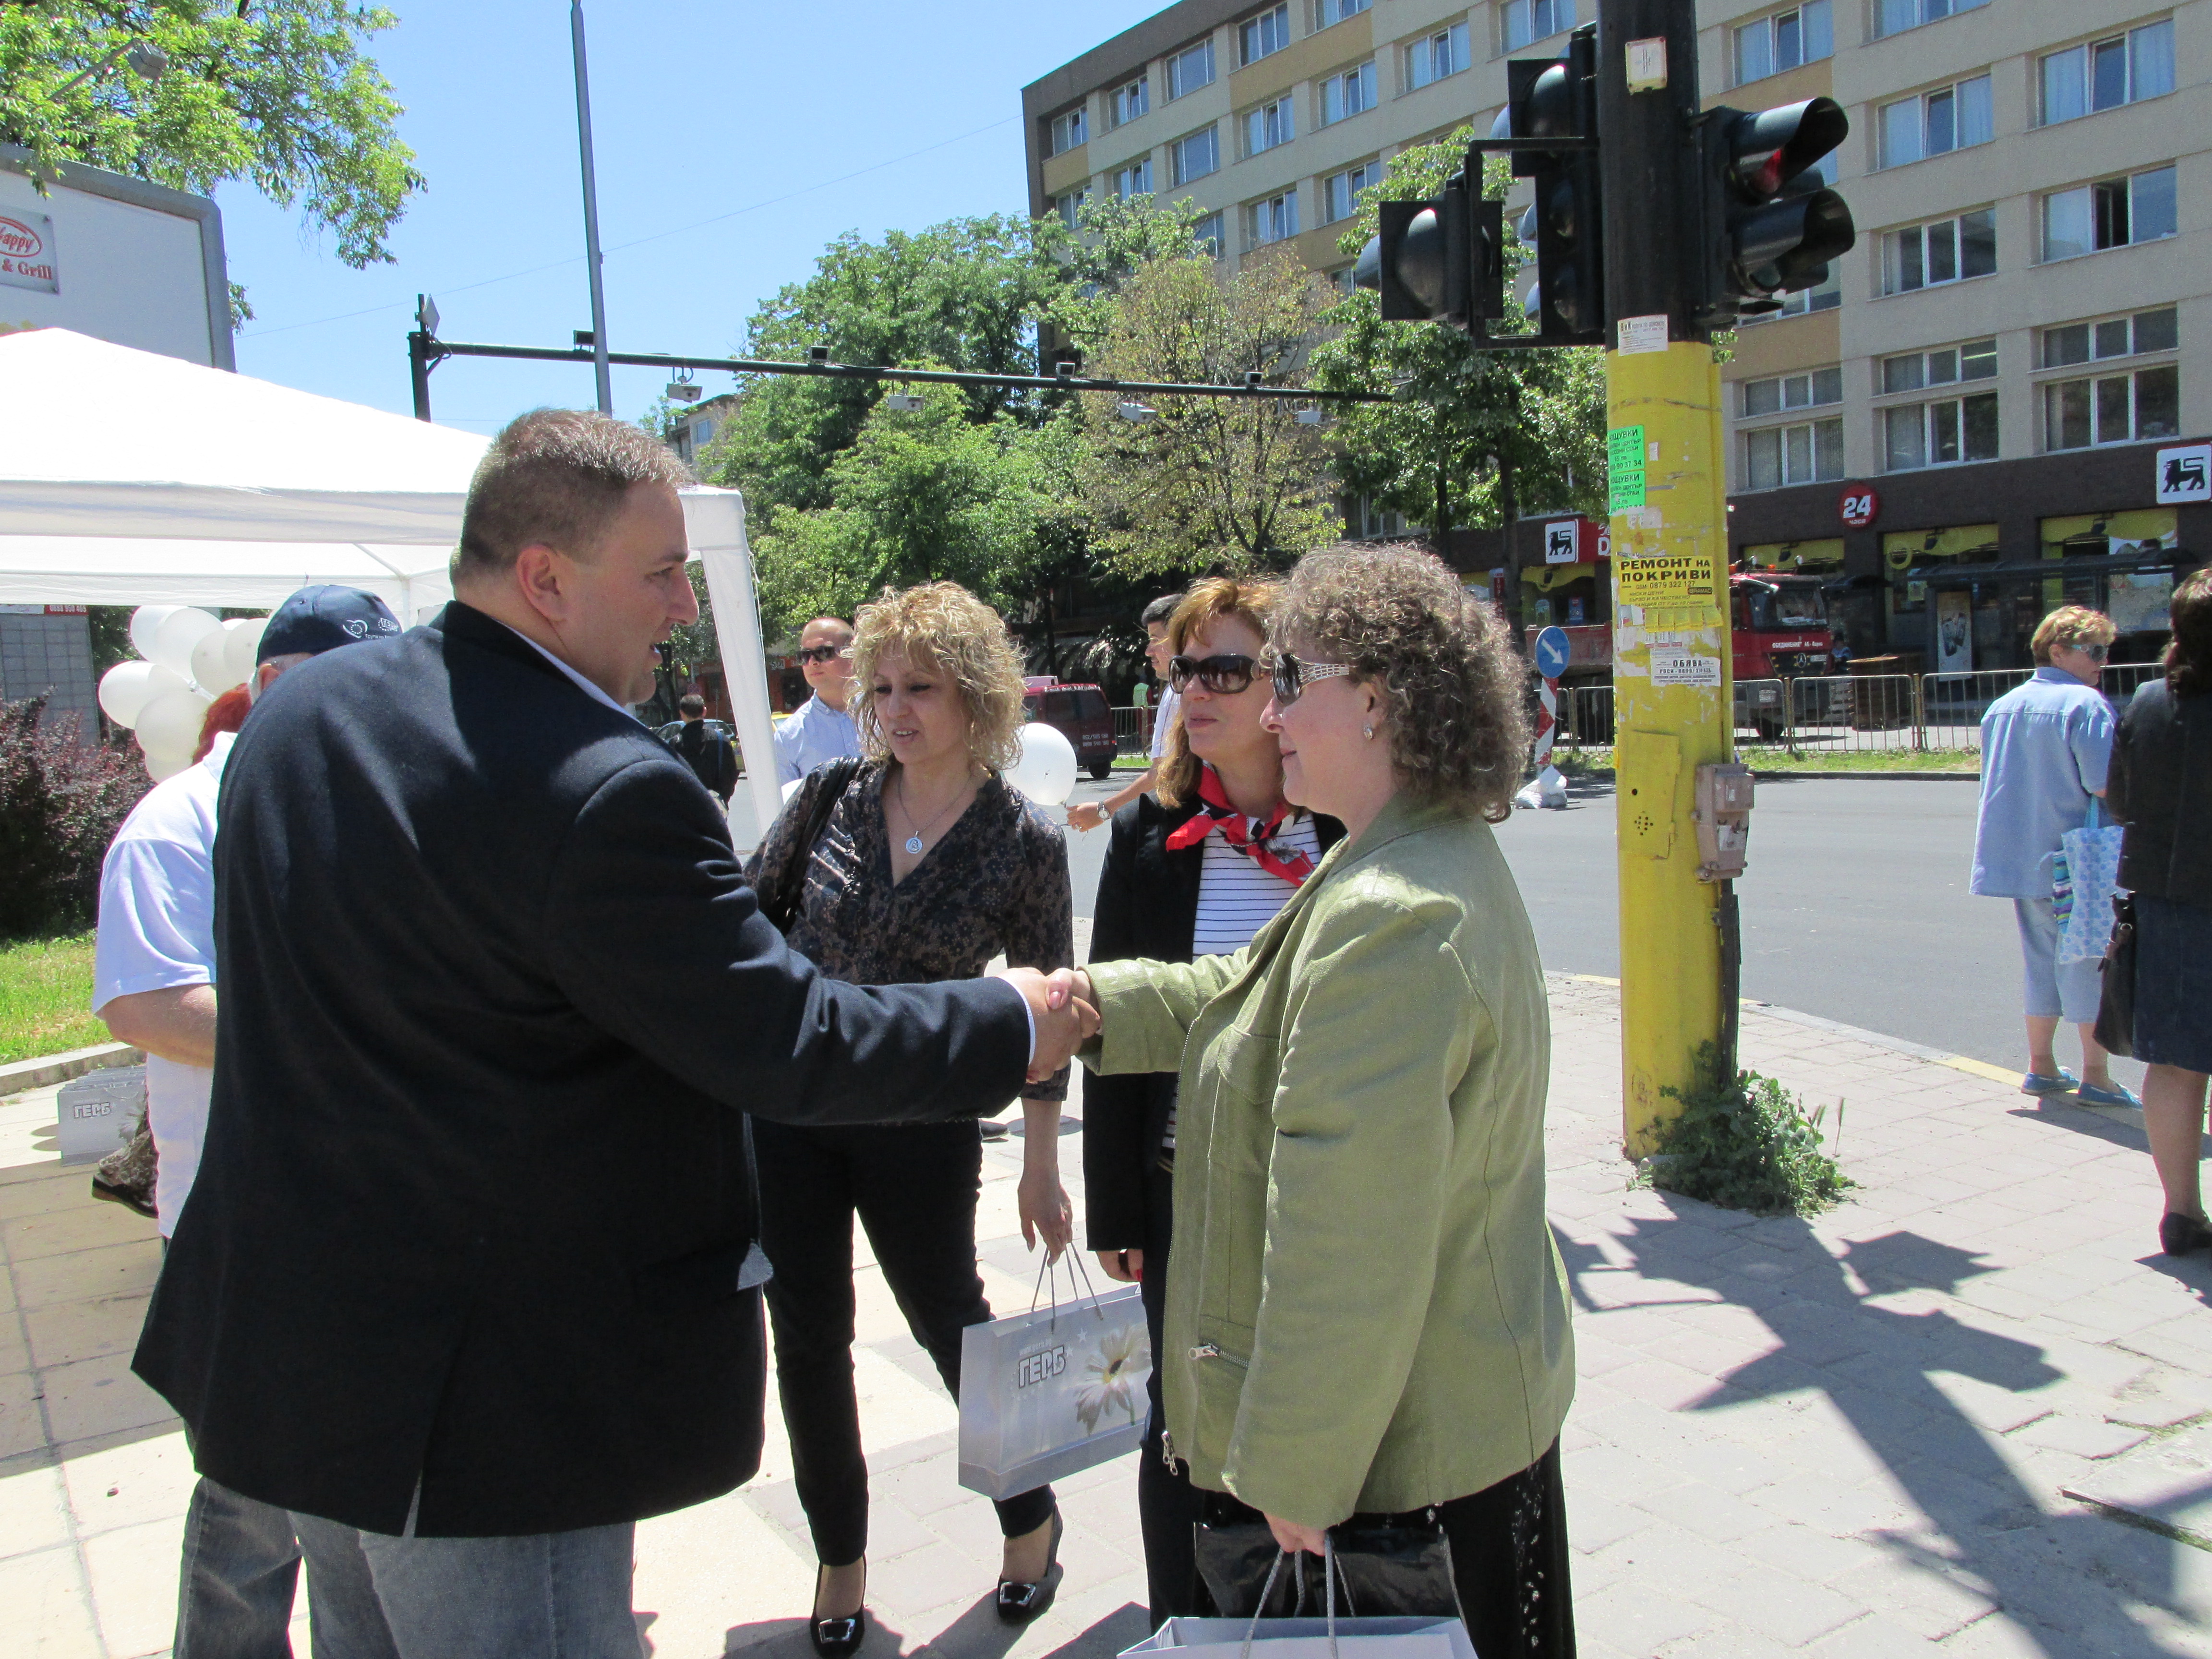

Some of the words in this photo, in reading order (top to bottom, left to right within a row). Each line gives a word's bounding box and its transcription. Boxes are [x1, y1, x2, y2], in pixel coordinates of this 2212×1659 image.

[2, 258, 13, 272] &
[17, 261, 53, 280] Grill
[1843, 495, 1871, 518] 24
[1621, 558, 1692, 570] РЕМОНТ
[1621, 570, 1711, 583] ПОКРИВИ
[73, 1102, 111, 1118] ГЕРБ
[1019, 1344, 1066, 1389] ГЕРБ
